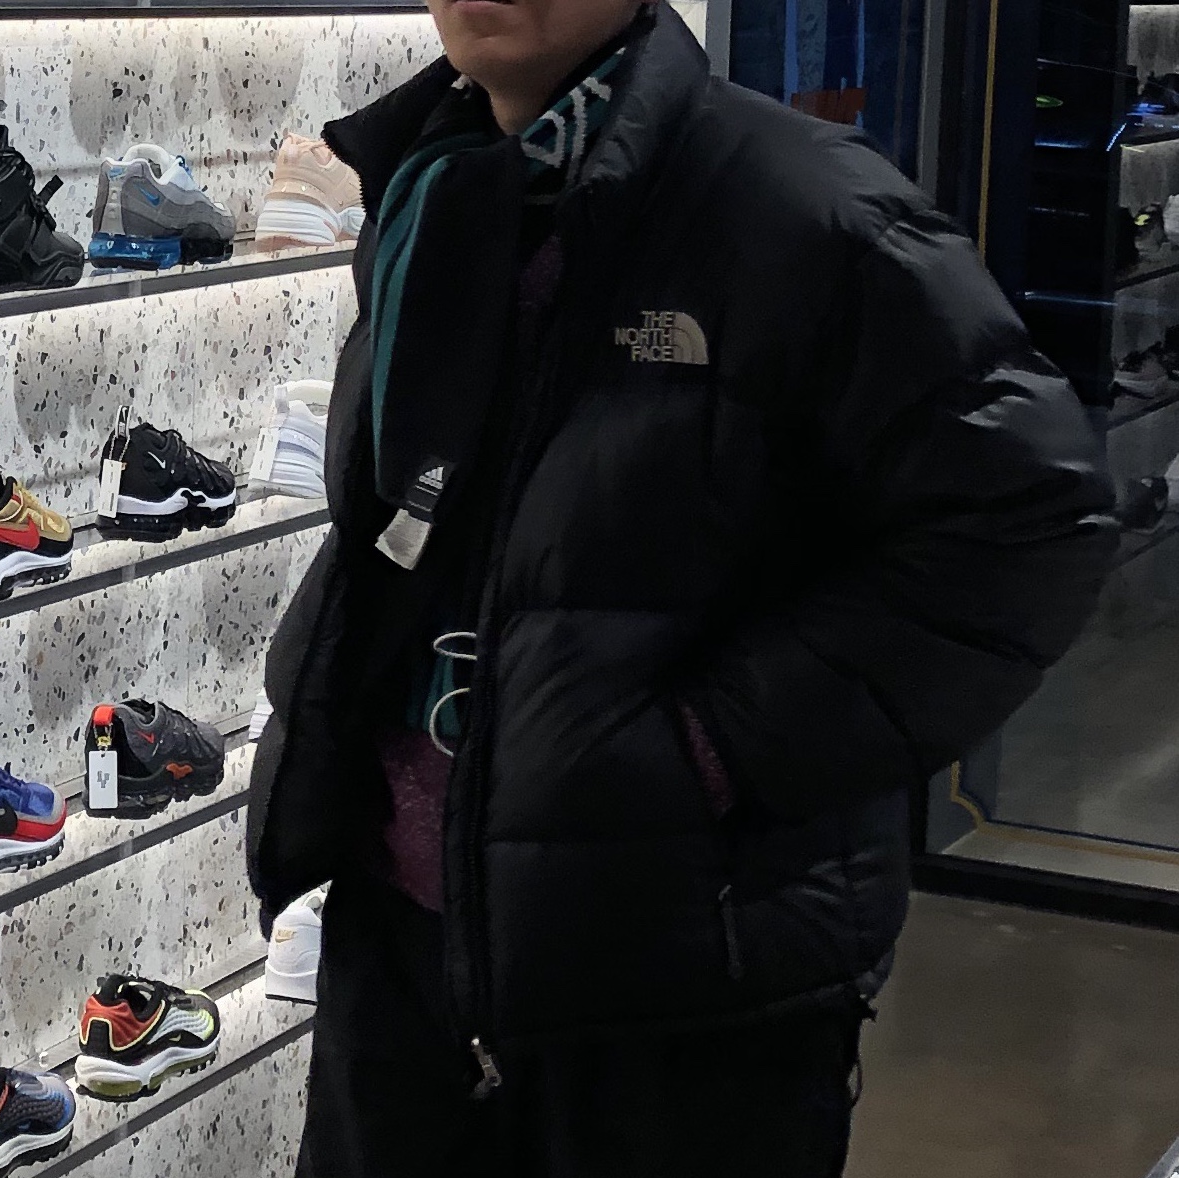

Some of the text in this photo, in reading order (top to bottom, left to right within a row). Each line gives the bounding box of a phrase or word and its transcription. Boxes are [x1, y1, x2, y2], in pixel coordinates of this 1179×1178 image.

[641, 311, 674, 327] THE
[615, 327, 672, 345] NORTH
[631, 345, 674, 361] FACE
